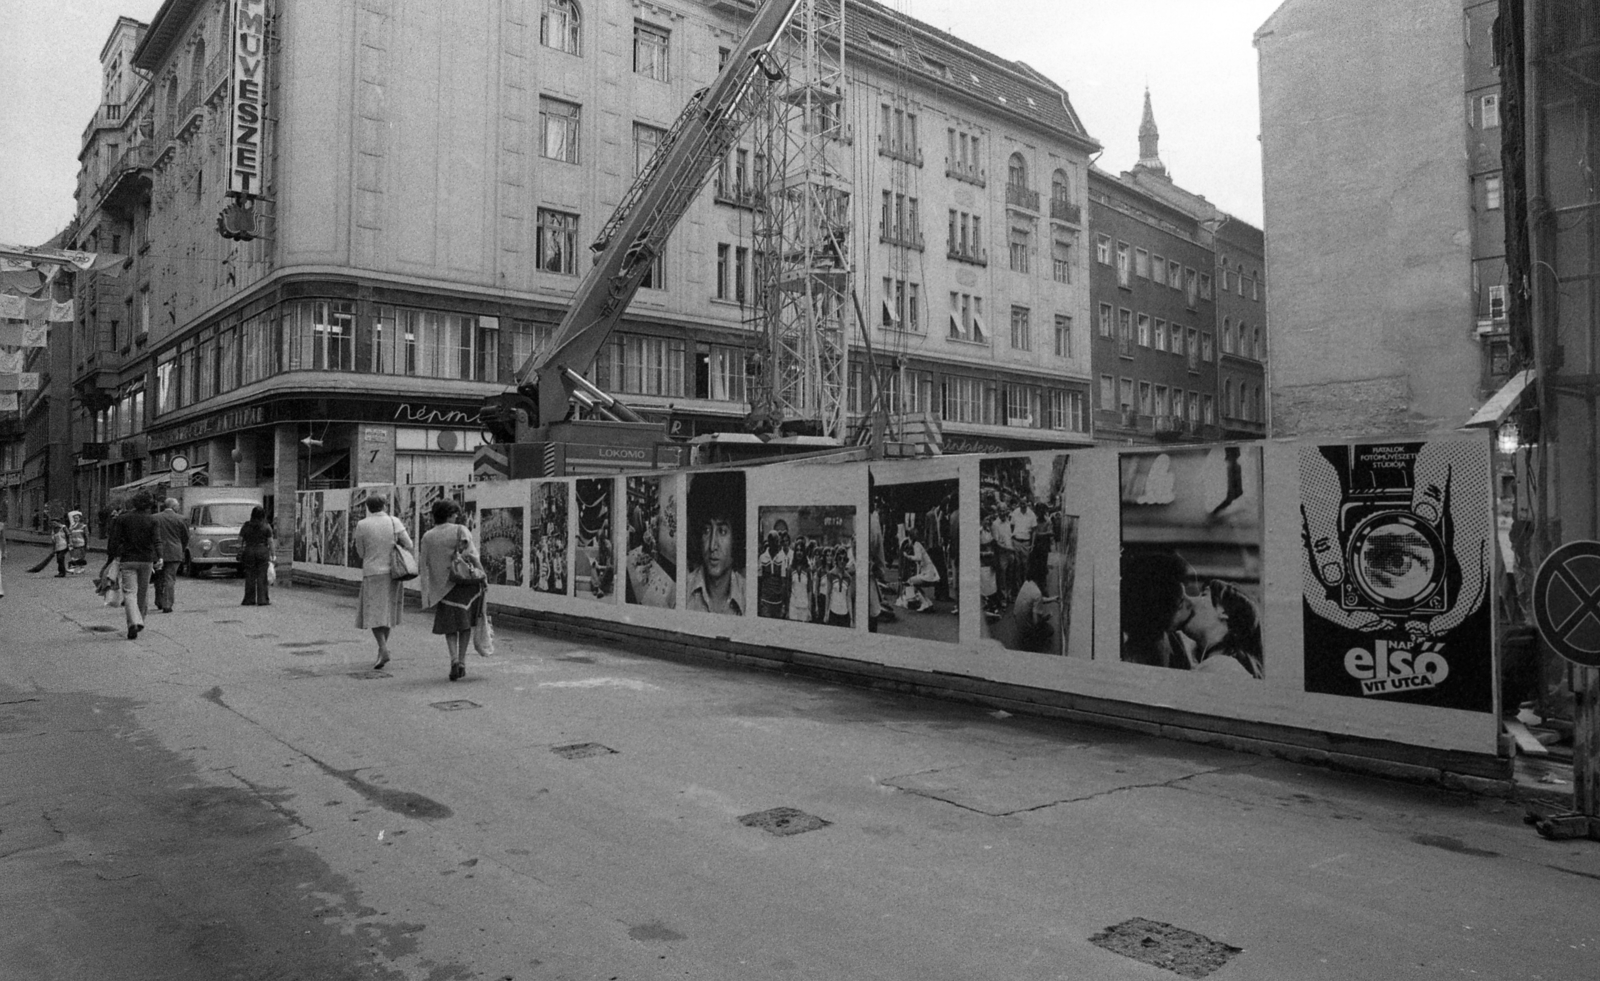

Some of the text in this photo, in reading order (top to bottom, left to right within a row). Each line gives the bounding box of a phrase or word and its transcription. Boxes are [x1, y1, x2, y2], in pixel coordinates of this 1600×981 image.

[370, 449, 380, 463] 7
[599, 448, 645, 459] LOKOMO
[1388, 640, 1414, 650] NAP
[1344, 640, 1449, 685] első
[1363, 674, 1432, 692] VIT UTCA
